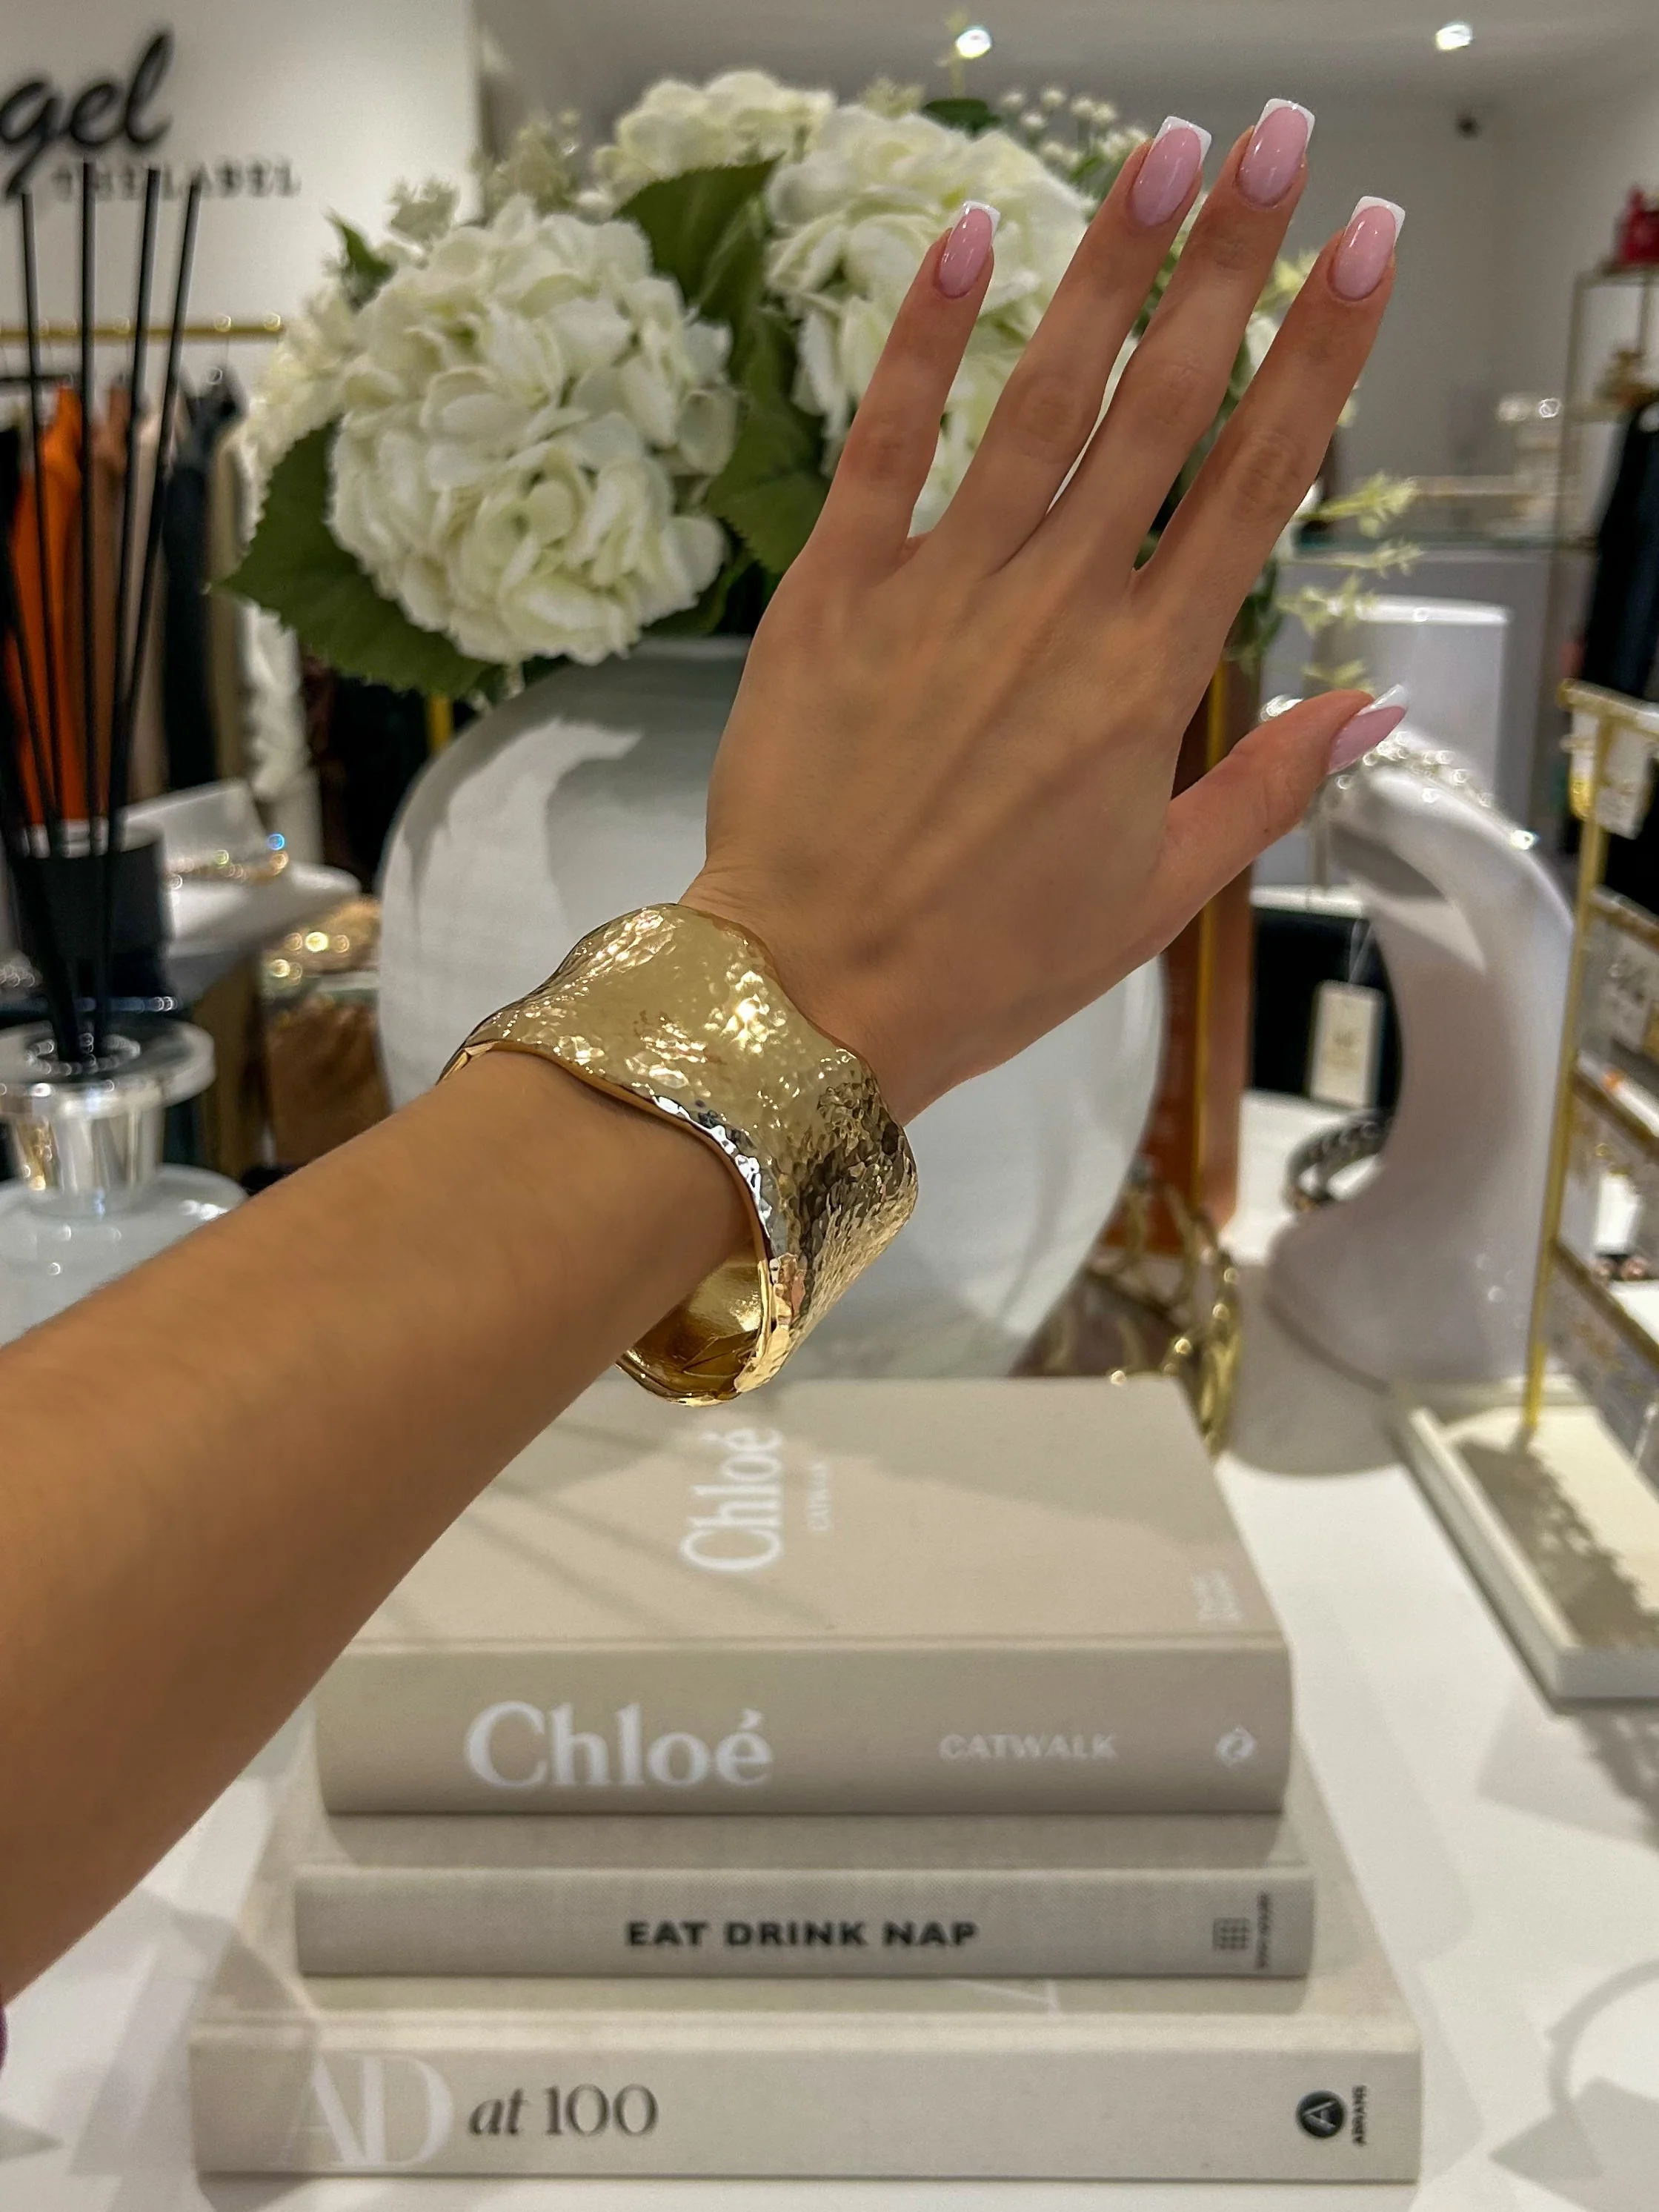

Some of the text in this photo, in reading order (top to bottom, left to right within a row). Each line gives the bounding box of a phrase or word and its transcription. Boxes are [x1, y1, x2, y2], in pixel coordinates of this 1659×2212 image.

[680, 1427, 784, 1572] Chloé
[465, 1700, 773, 1788] Chloé
[939, 1733, 1117, 1761] CATWALK
[627, 1919, 977, 1947] EAT DRINK NAP
[276, 2053, 658, 2168] AD at 100
